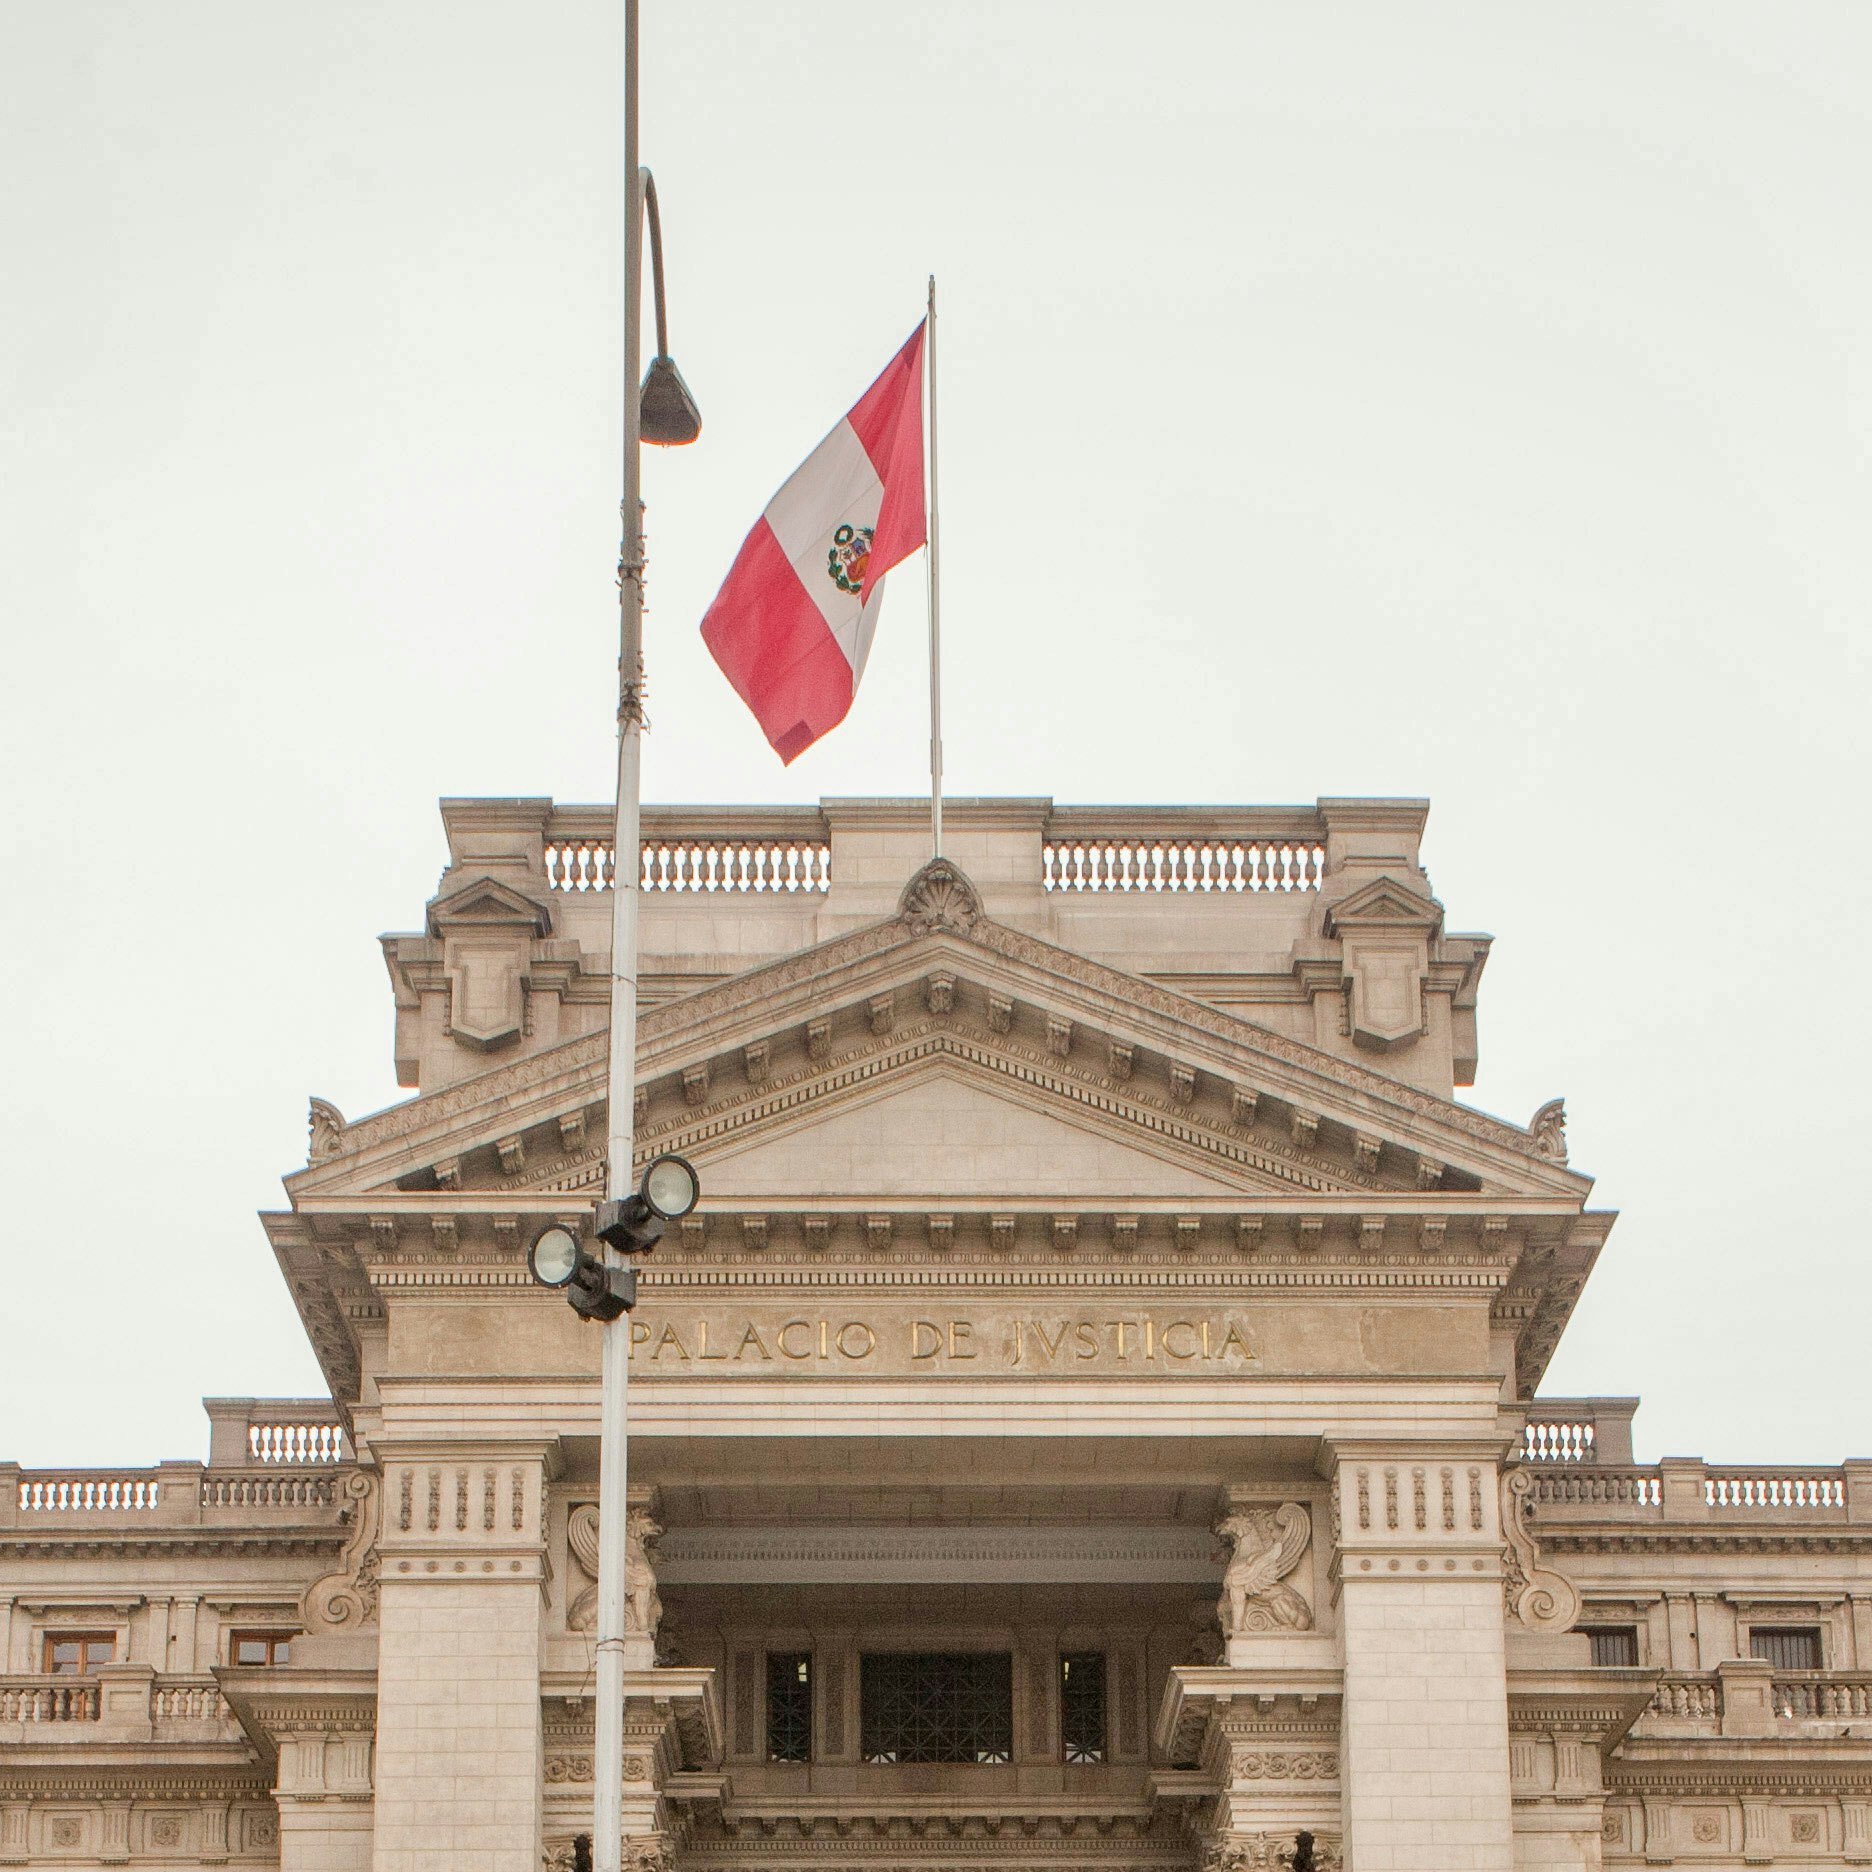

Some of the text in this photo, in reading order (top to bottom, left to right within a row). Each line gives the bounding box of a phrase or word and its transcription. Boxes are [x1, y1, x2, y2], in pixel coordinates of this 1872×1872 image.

[628, 1320, 1259, 1366] PALACIO DE JVSTICIA
